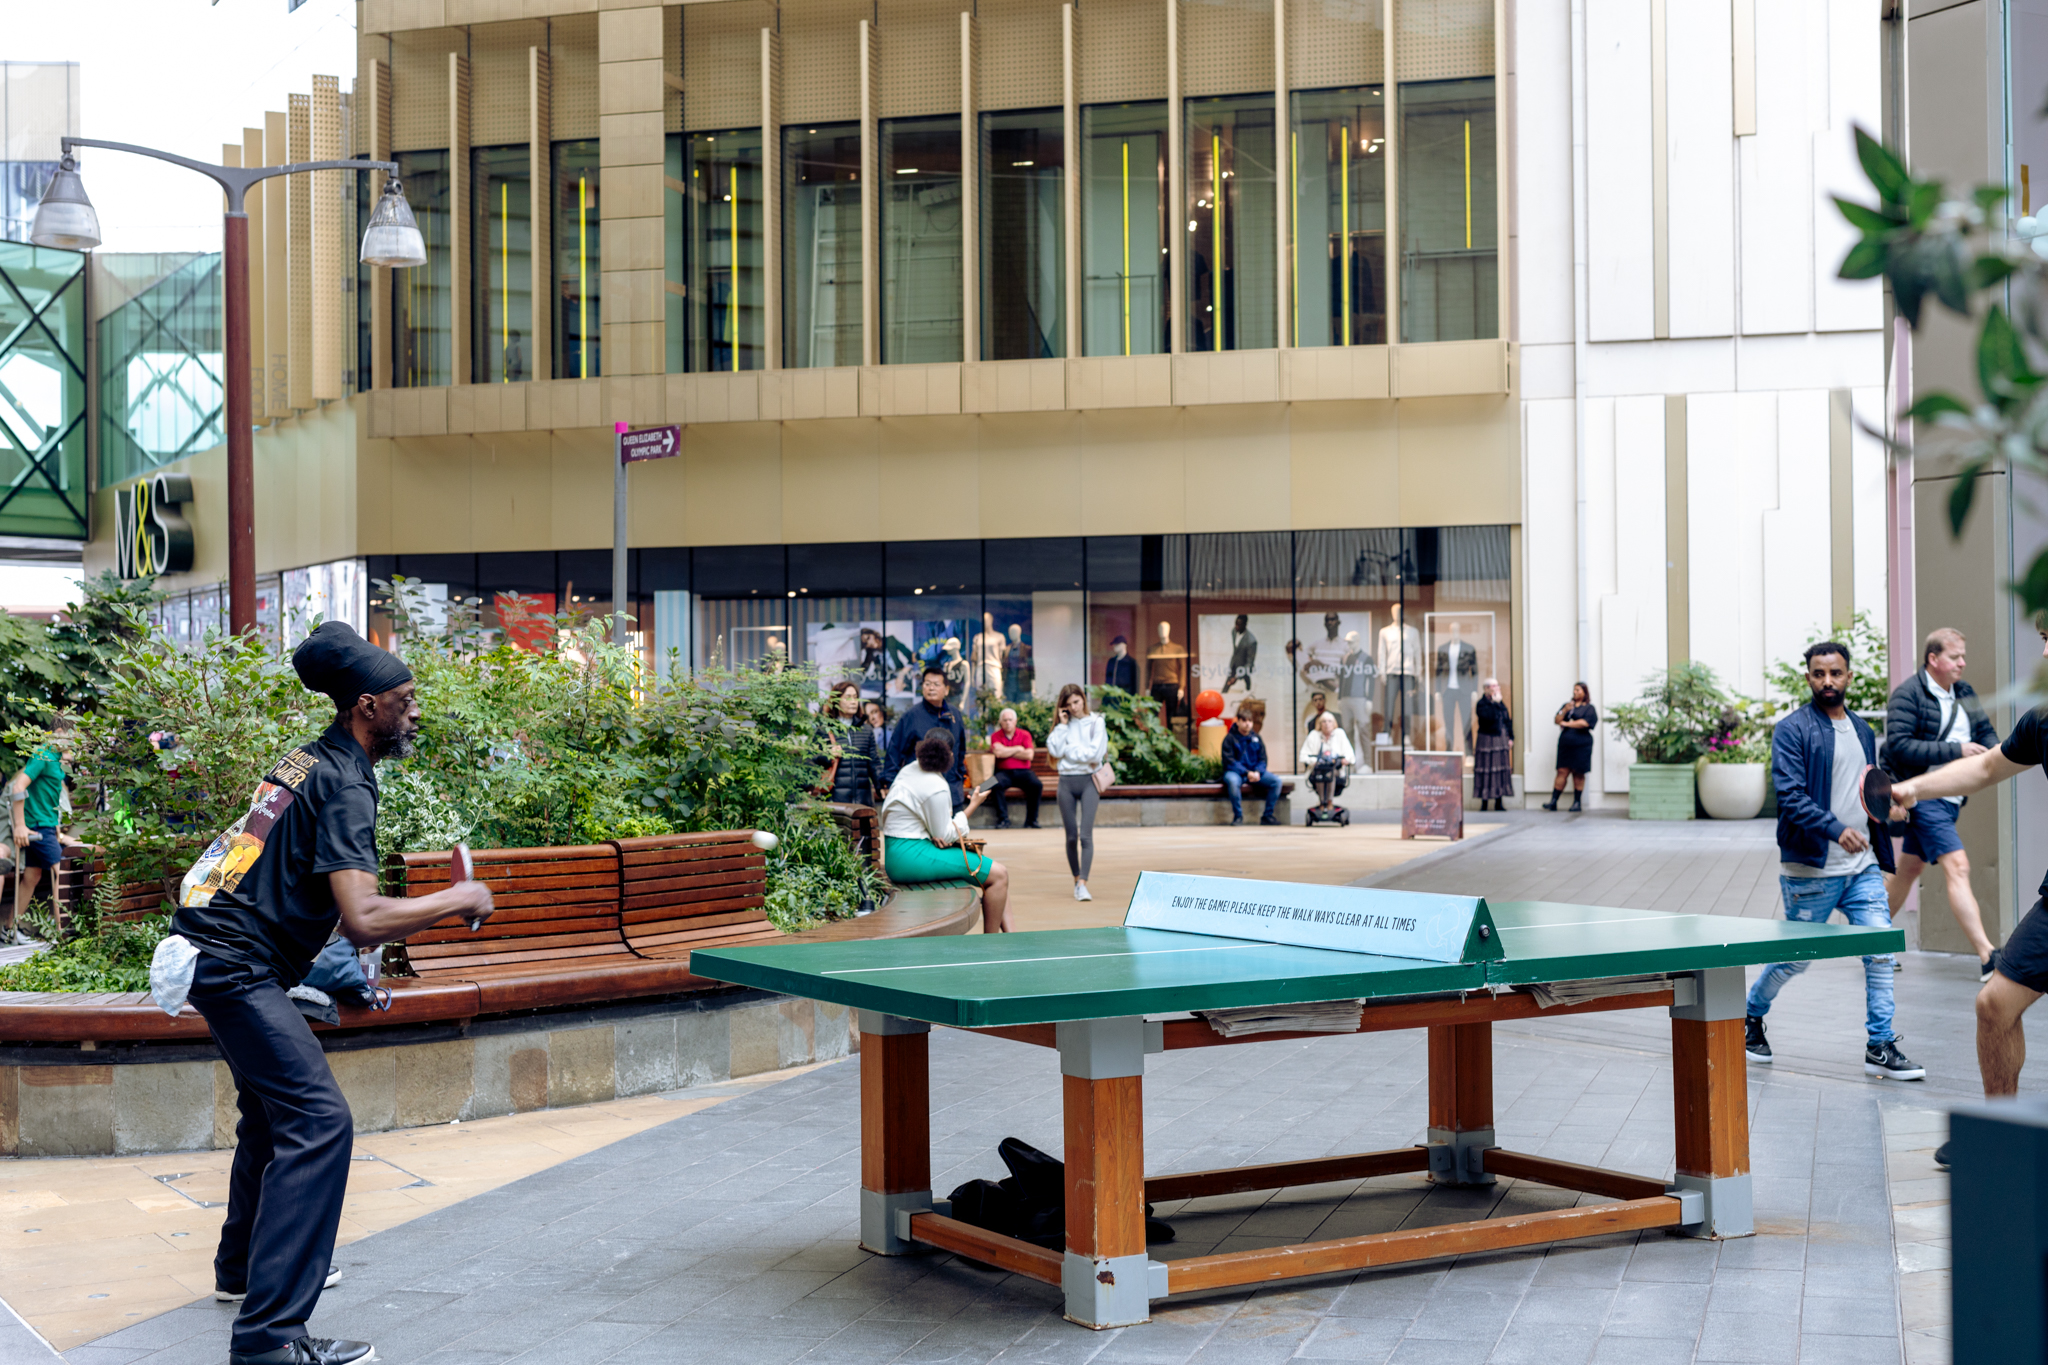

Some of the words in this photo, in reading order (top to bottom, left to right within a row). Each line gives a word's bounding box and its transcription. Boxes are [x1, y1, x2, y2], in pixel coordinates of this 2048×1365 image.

[623, 435, 638, 446] QUEEN
[639, 431, 663, 444] ELIZABETH
[631, 446, 650, 457] OLYMPIC
[650, 445, 663, 455] PARK
[115, 472, 171, 580] M&S
[1190, 664, 1232, 680] Style
[1236, 664, 1261, 678] ou
[1309, 661, 1380, 679] everyday
[1171, 896, 1195, 909] ENJOY
[1194, 898, 1208, 911] THE
[1207, 899, 1231, 913] GAME!
[1230, 901, 1257, 916] PLEASE
[1257, 904, 1276, 918] KEEP
[1277, 906, 1292, 920] THE
[1291, 908, 1314, 922] WALK
[1314, 910, 1335, 924] WAYS
[1335, 912, 1361, 927] CLEAR
[1361, 914, 1374, 928] AT
[1373, 916, 1389, 930] ALL
[1391, 917, 1417, 932] TIMES
